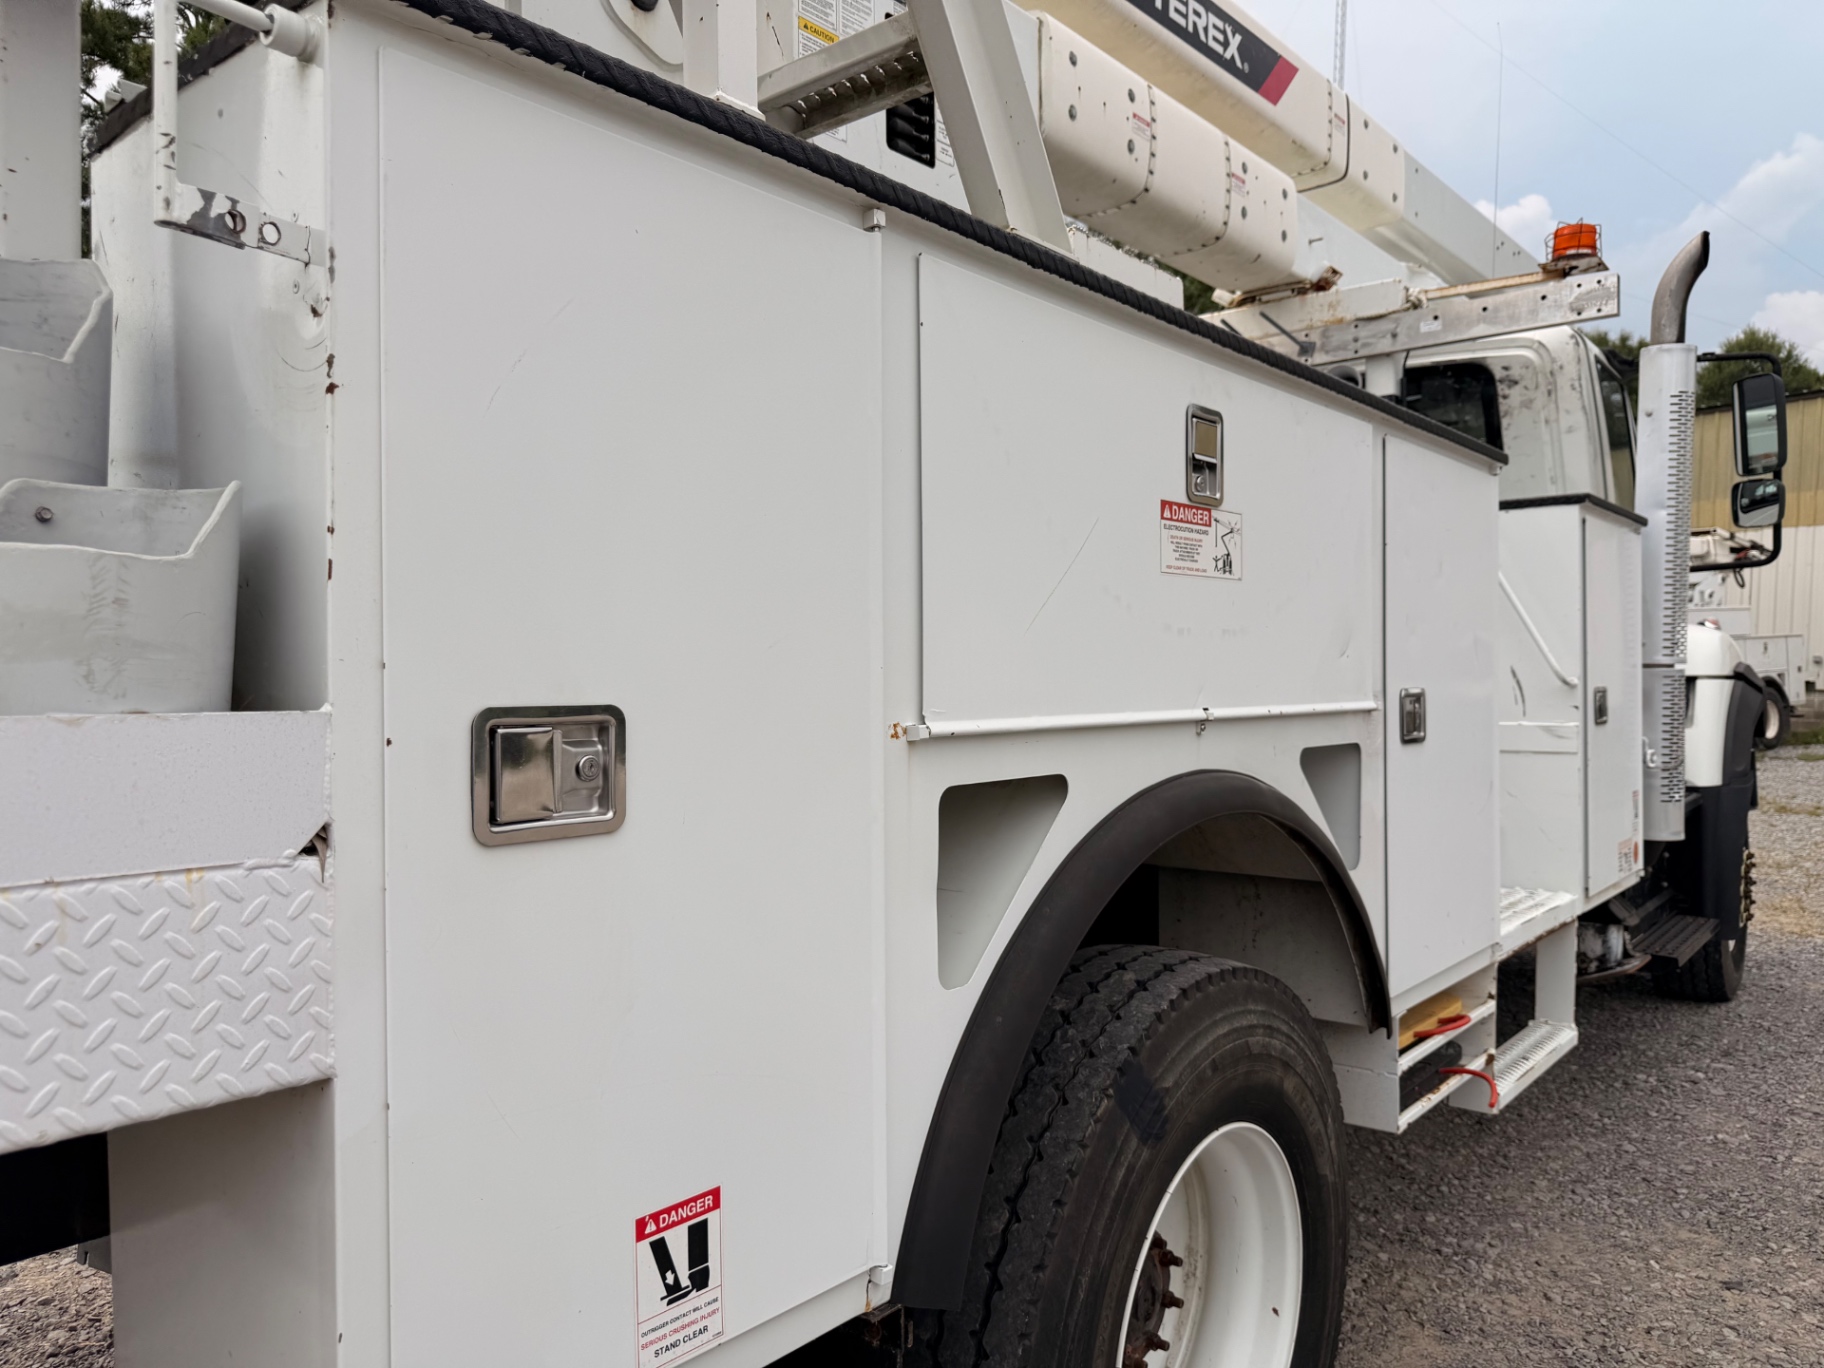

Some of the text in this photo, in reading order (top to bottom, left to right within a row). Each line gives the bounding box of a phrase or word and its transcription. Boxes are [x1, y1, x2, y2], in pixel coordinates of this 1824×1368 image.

[809, 26, 834, 44] CAUTION
[1163, 524, 1193, 533] ELECTROCUTION
[1172, 506, 1209, 525] DANGER
[659, 1195, 713, 1228] DANGER
[641, 1296, 719, 1338] OUTRIGGER CONTACT WILL CAUSE
[641, 1307, 720, 1350] SERIOUS CRUSHING INJURY
[654, 1325, 709, 1358] STAND CLEAR
